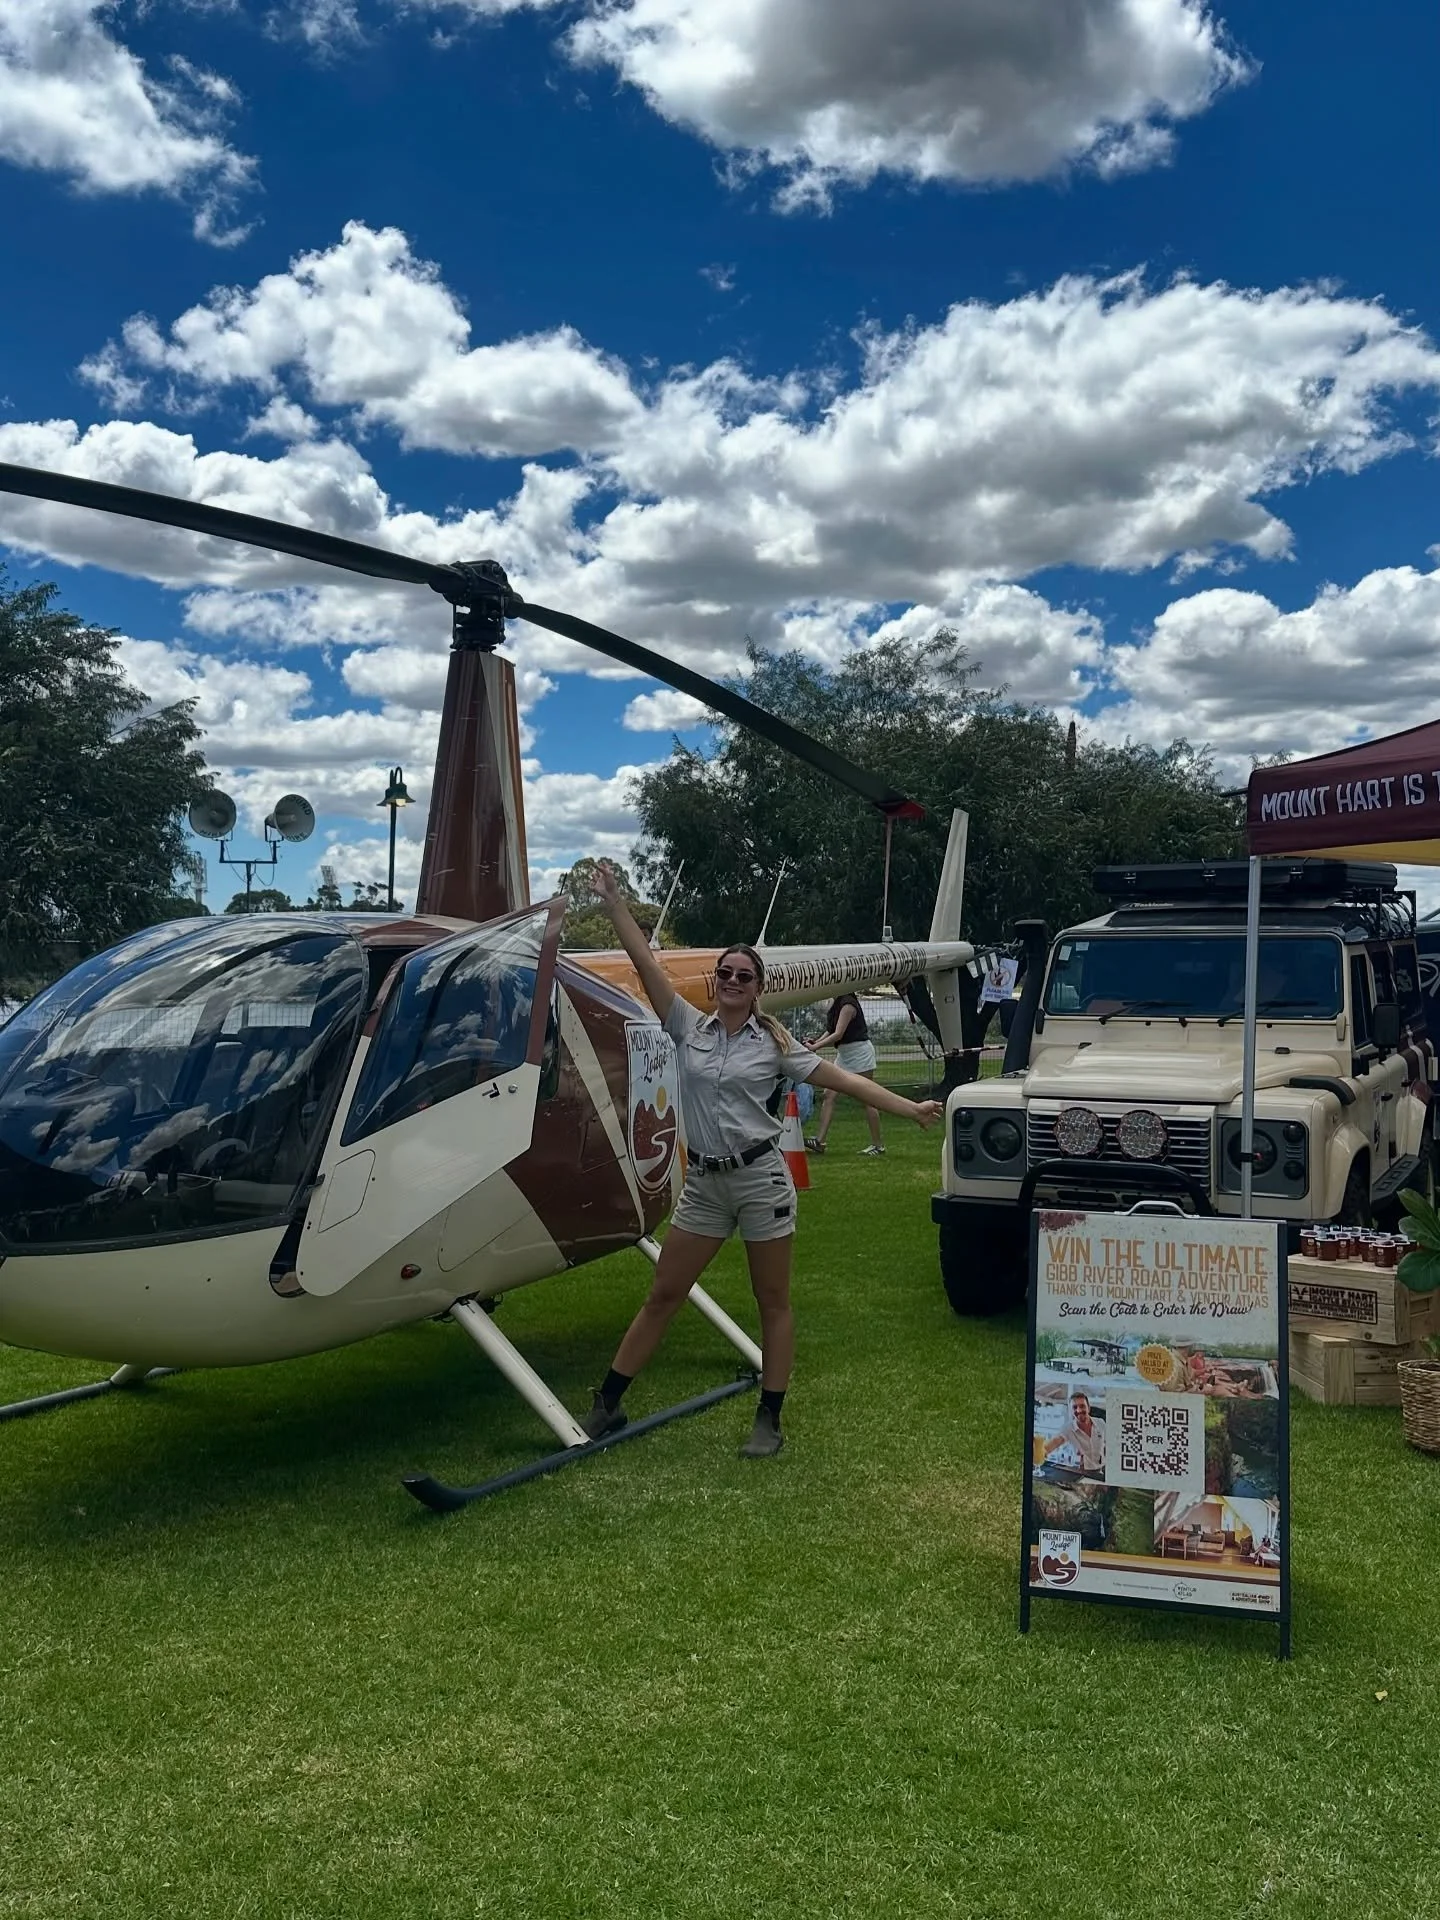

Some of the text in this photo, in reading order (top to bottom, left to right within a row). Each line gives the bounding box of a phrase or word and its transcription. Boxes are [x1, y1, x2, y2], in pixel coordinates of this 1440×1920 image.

[1261, 785, 1330, 823] MOUNT
[1336, 777, 1395, 813] HART
[1403, 773, 1425, 806] IS
[784, 960, 815, 990] RIVER
[815, 957, 843, 986] ROAD
[844, 952, 892, 983] ADVENTURE
[630, 1030, 654, 1051] MOUNT
[1047, 1235, 1268, 1276] WIN THE ULTIMATE
[1046, 1263, 1268, 1295] GIBB RIVER ROAD ADVENTURE
[1046, 1282, 1086, 1297] THANKS
[1090, 1284, 1103, 1298] TO
[1107, 1286, 1142, 1301] MOUNT
[1145, 1288, 1172, 1303] HART
[1177, 1289, 1185, 1303] &
[1235, 1293, 1269, 1309] ATLAS
[1312, 1287, 1374, 1301] MOUNT HART
[1059, 1300, 1254, 1318] Scan the Code to Enter the Draw!
[1146, 1435, 1164, 1445] PER
[1042, 1532, 1078, 1543] MOUNT HART
[1050, 1541, 1071, 1551] Lodge
